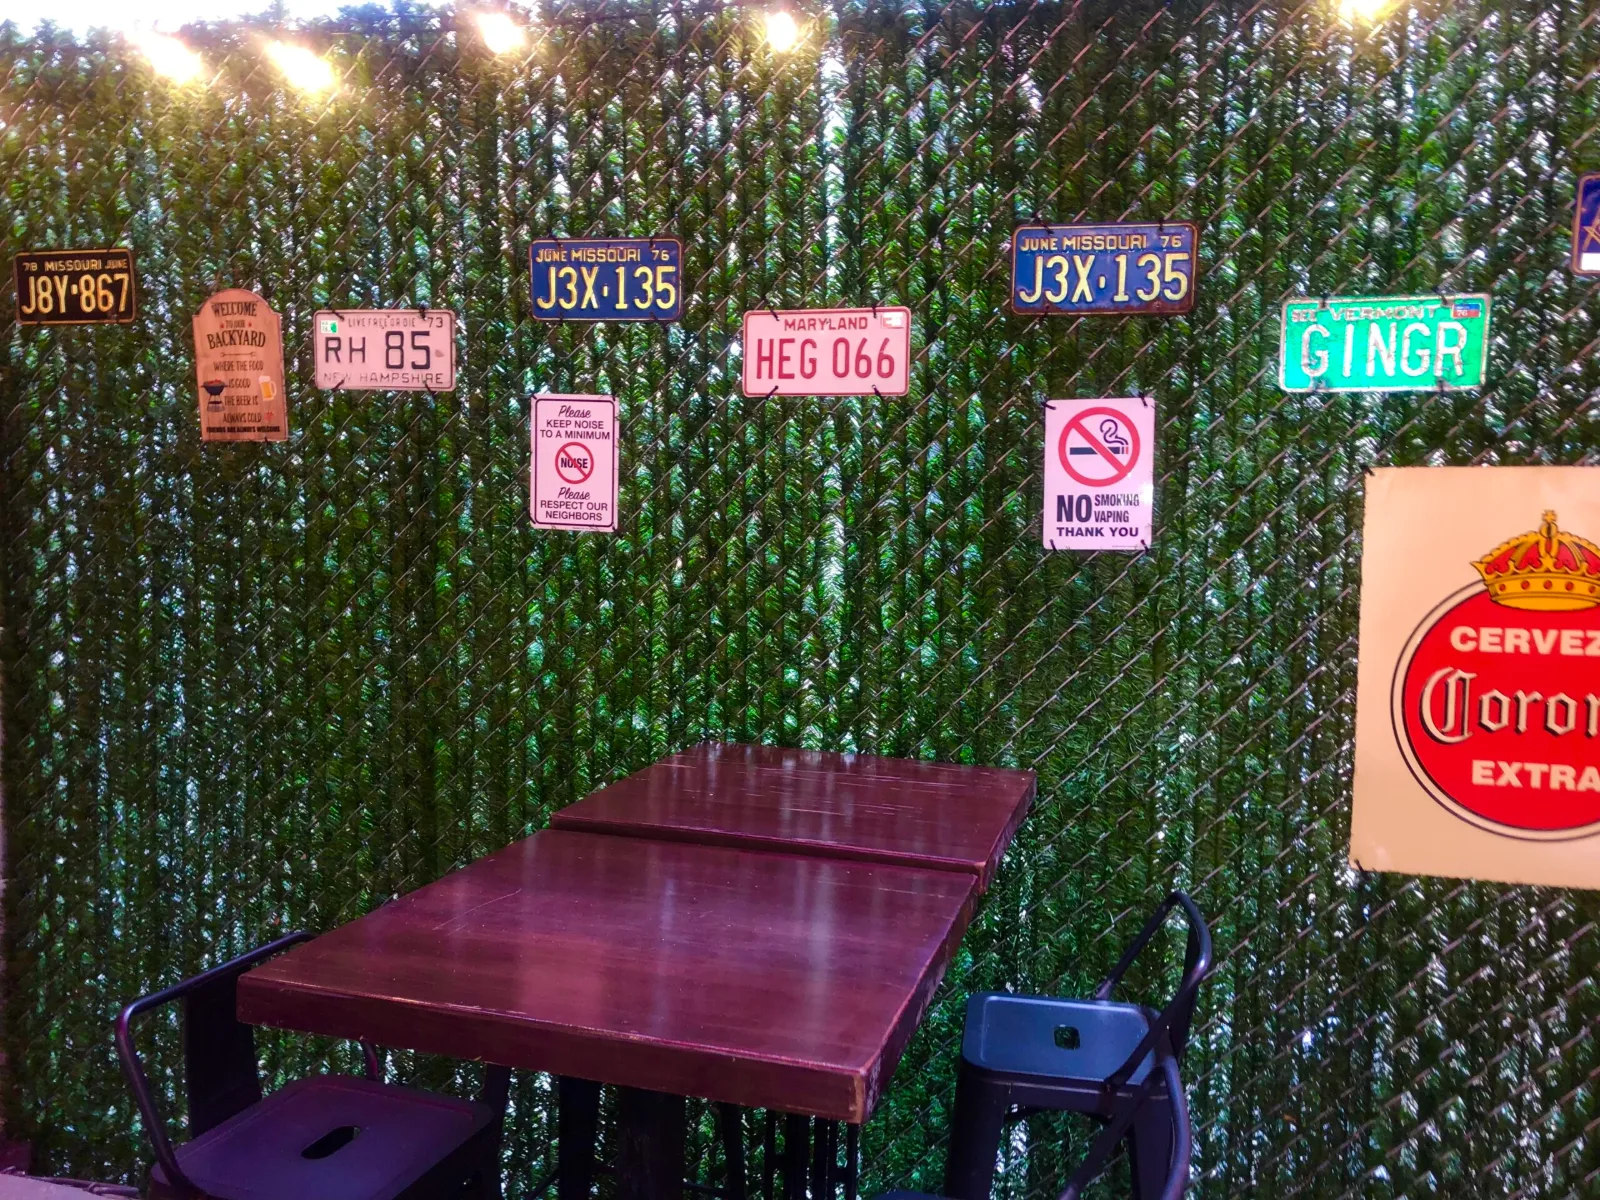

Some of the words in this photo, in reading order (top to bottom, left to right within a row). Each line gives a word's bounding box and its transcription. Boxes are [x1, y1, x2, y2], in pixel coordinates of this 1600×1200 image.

[1020, 238, 1058, 251] JUNE
[1062, 234, 1147, 250] MISSOURI
[1160, 235, 1182, 248] 76
[535, 250, 568, 263] JUNE
[571, 248, 640, 262] MISSOURI
[651, 250, 670, 261] 76
[22, 262, 38, 271] 78
[44, 259, 101, 271] MISSOURI
[104, 259, 128, 269] JUNE
[211, 302, 258, 317] WELCOME
[1330, 304, 1436, 321] VERMONT
[348, 318, 366, 328] LIVE
[428, 317, 444, 328] 73
[785, 317, 868, 331] MARYLAND
[206, 329, 266, 349] BACKYARD
[325, 337, 366, 363] RH
[385, 331, 431, 370] 85
[1301, 322, 1468, 377] GINGR
[756, 338, 817, 379] HEG
[832, 337, 895, 378] 066
[323, 373, 352, 381] NEW
[360, 373, 444, 384] HAMPSHIRE
[558, 405, 592, 418] Please
[546, 420, 571, 428] KEEP
[575, 420, 604, 429] NOISE
[540, 430, 553, 438] TO
[556, 430, 562, 438] A
[564, 431, 610, 440] MINIMUM
[560, 458, 588, 469] NOISE
[558, 487, 591, 500] Please
[1094, 494, 1140, 506] SMOKING
[540, 500, 584, 510] RESPECT
[586, 502, 608, 511] OUR
[1056, 494, 1092, 522] NO
[546, 510, 602, 521] NEIGHBORS
[1094, 510, 1129, 522] VAPING
[1056, 527, 1104, 536] THANK
[1108, 527, 1138, 537] YOU
[1472, 760, 1600, 792] EXTRA
